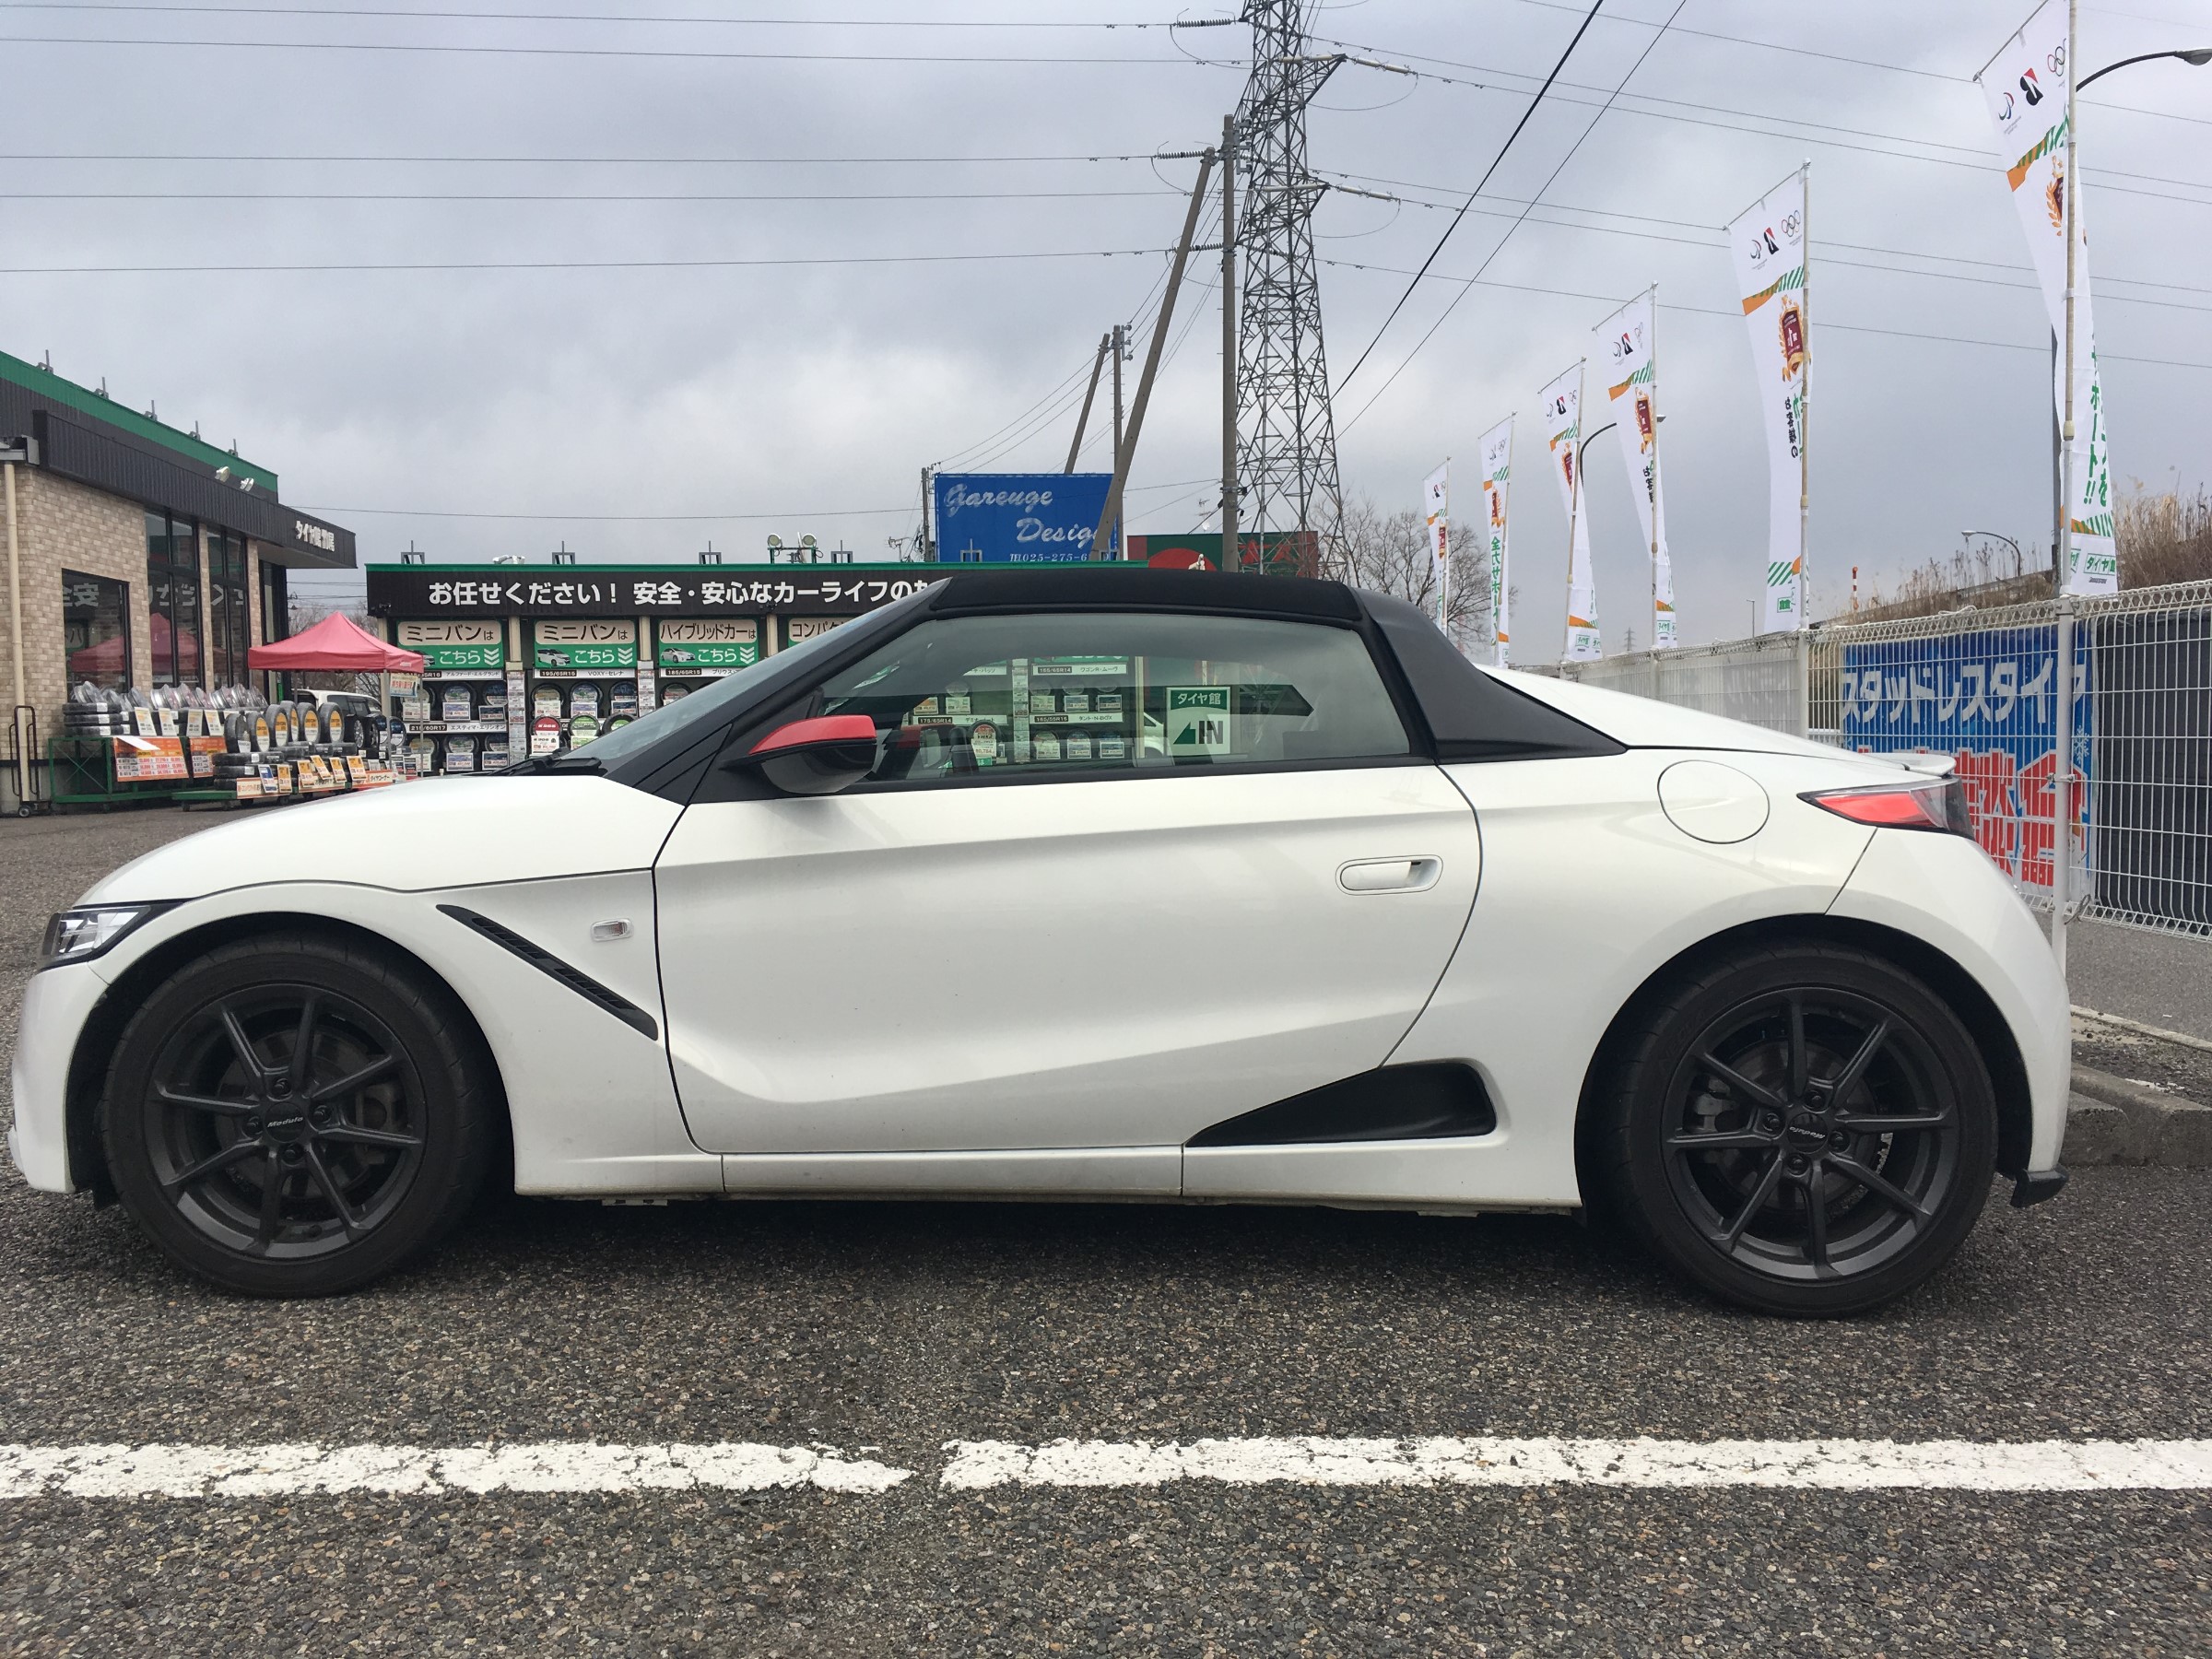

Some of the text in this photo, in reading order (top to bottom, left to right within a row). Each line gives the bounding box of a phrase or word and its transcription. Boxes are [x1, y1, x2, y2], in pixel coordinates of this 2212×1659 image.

[1016, 517, 1098, 549] Desig
[406, 624, 494, 642] ミニバンは
[543, 623, 629, 642] ミニバンは
[660, 623, 757, 641] ハイブリッドカーは
[792, 621, 842, 638] コンパ
[439, 649, 481, 665] こちら
[574, 648, 615, 664] こちら
[698, 648, 737, 663] こちら
[1177, 693, 1221, 705] タイヤ館
[1198, 720, 1224, 745] IN
[266, 1115, 304, 1128] Modulo
[1789, 1125, 1826, 1139] Modulo
